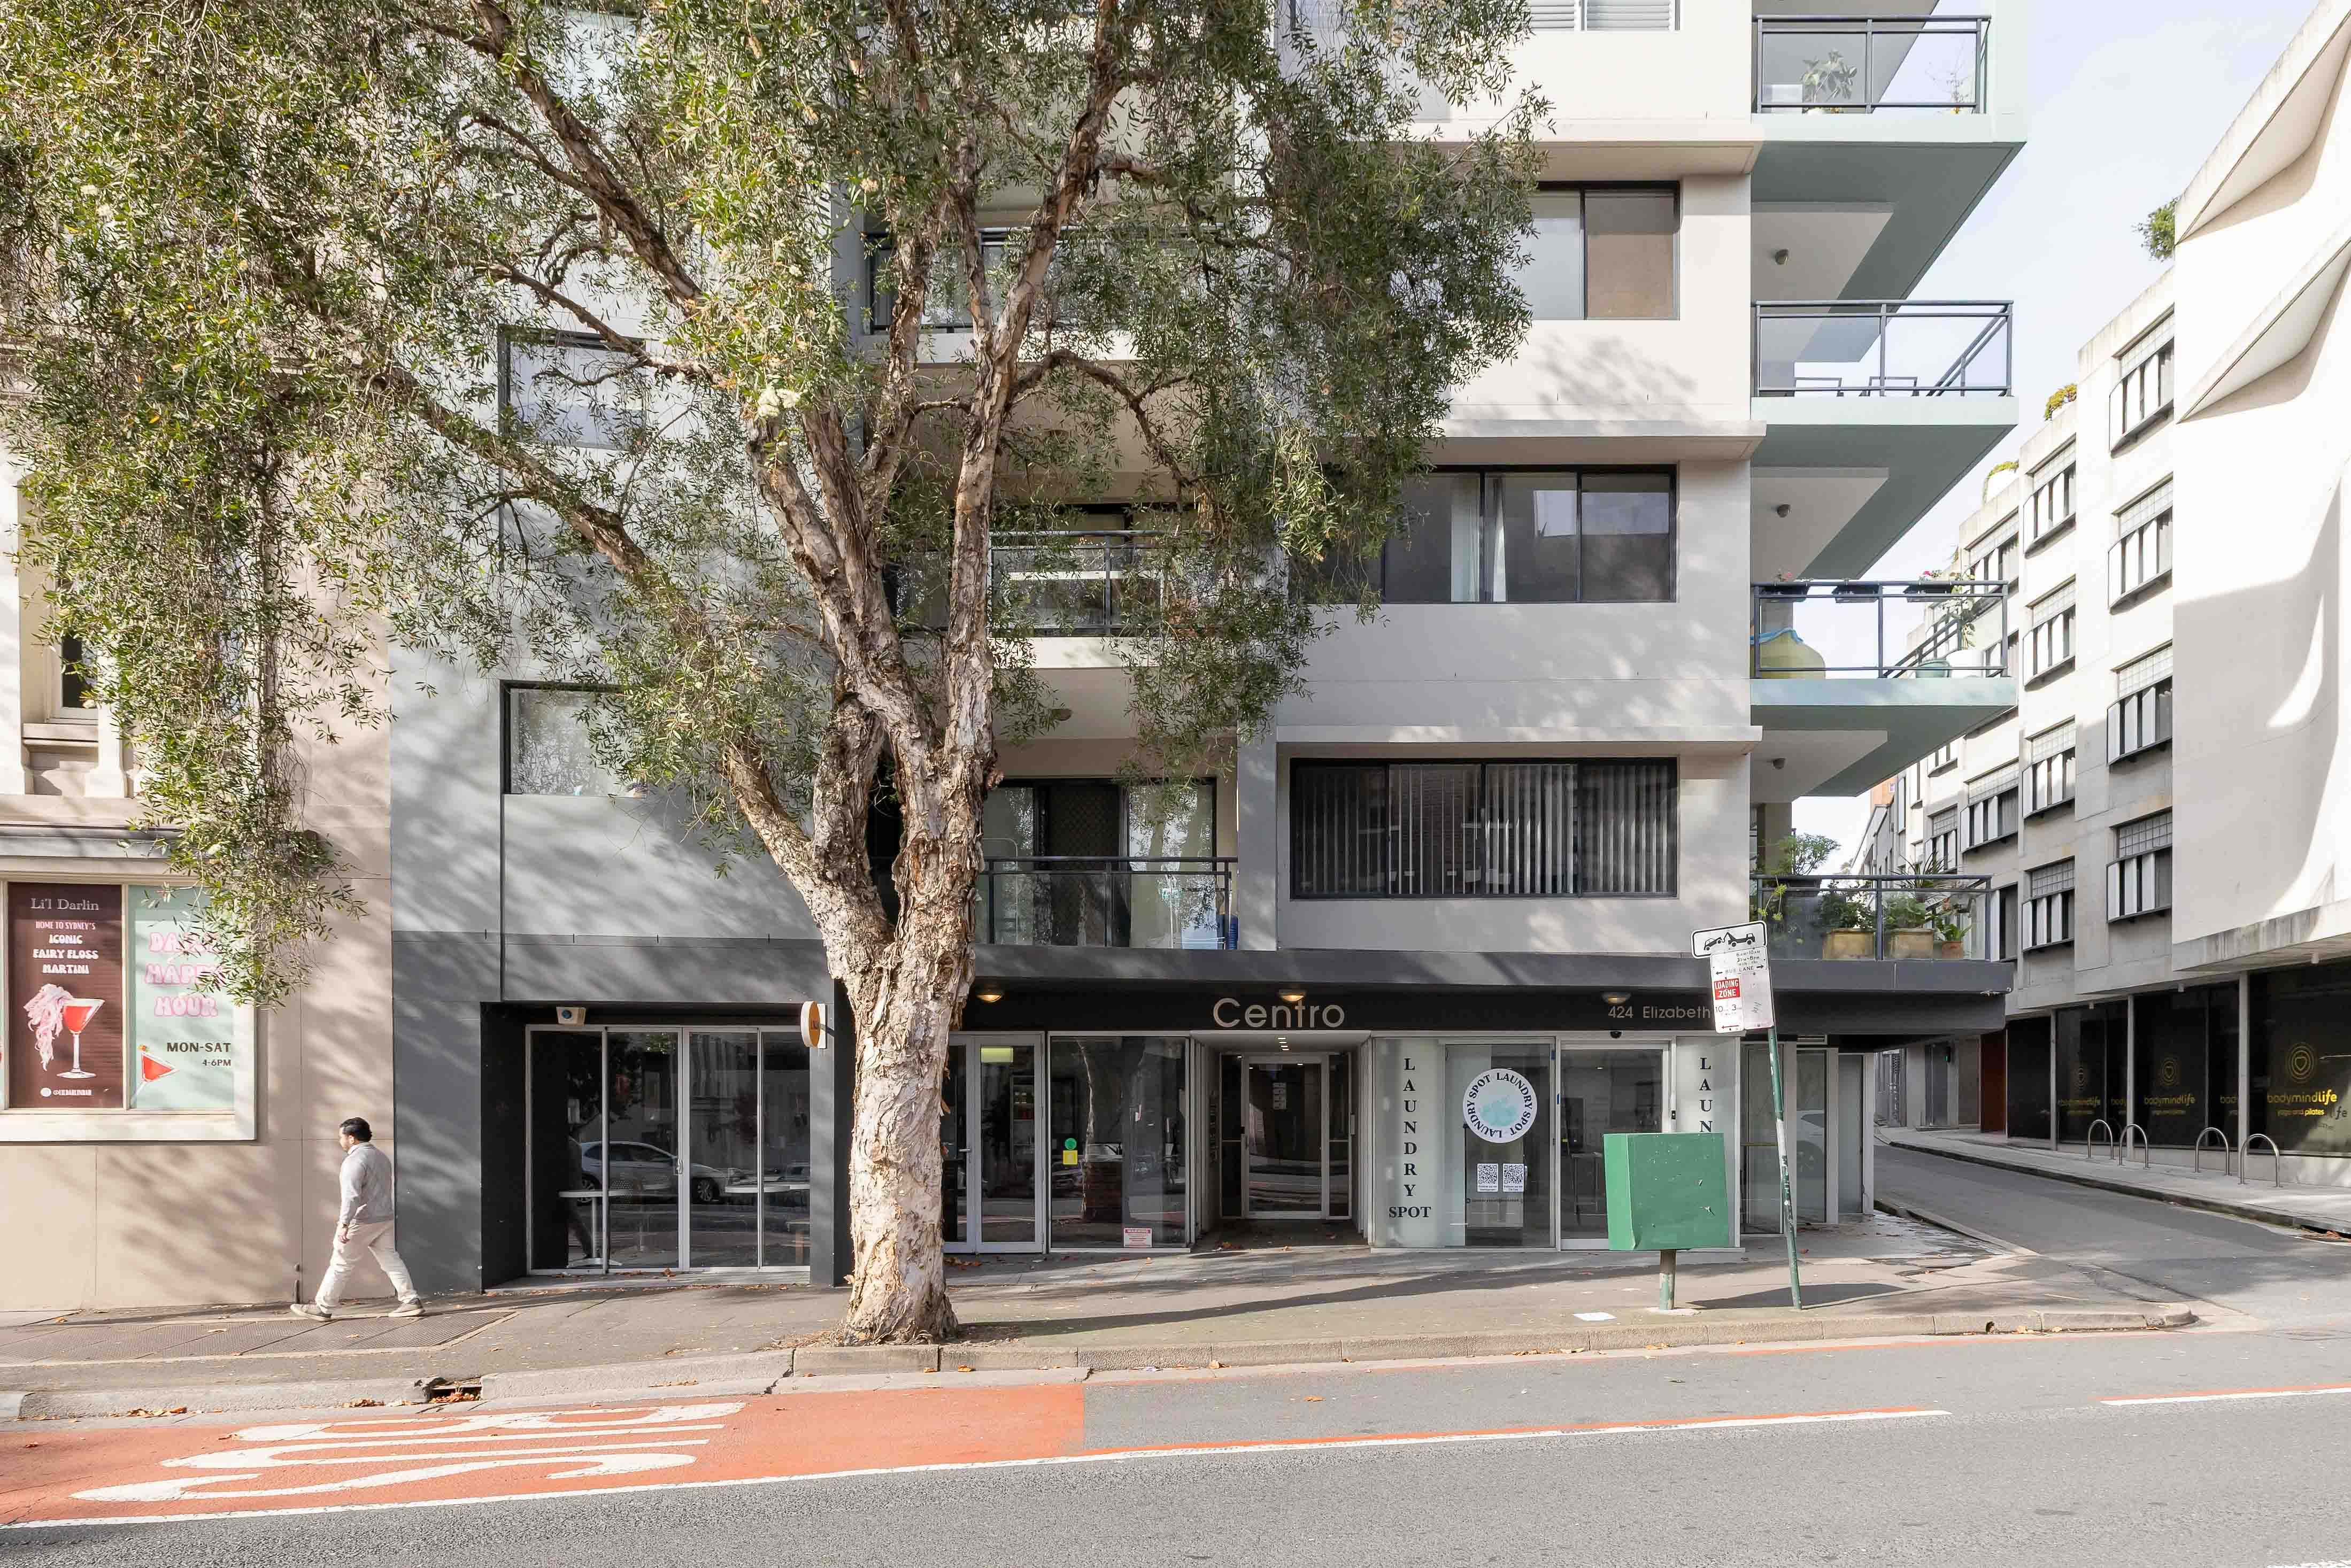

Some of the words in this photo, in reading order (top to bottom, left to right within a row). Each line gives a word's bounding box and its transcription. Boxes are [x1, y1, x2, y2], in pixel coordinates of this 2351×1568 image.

[30, 898, 51, 909] Li'l
[57, 899, 99, 910] Darlin
[65, 922, 96, 930] SYDNEY'S
[49, 934, 83, 944] ICONIC
[33, 948, 65, 959] FAIRY
[67, 949, 99, 959] FLOSS
[42, 964, 90, 974] MARTINI
[1715, 979, 1739, 990] LOADING
[1718, 988, 1737, 998] ZONE
[154, 996, 219, 1017] HOUR
[1608, 1006, 1634, 1018] 424
[1643, 1006, 1711, 1018] Elizabeth
[1213, 998, 1345, 1028] Centro
[166, 1042, 231, 1052] MON-SAT
[1469, 1075, 1491, 1099] SPOT
[1497, 1072, 1533, 1109] LAUNDRY
[2267, 1090, 2338, 1104] bodymindlife
[2304, 1108, 2325, 1116] pilates
[1467, 1100, 1502, 1138] LAUNDRY
[1510, 1111, 1531, 1136] SPOT
[1403, 1058, 1417, 1196] LAUNDRY
[1389, 1206, 1431, 1218] SPOT
